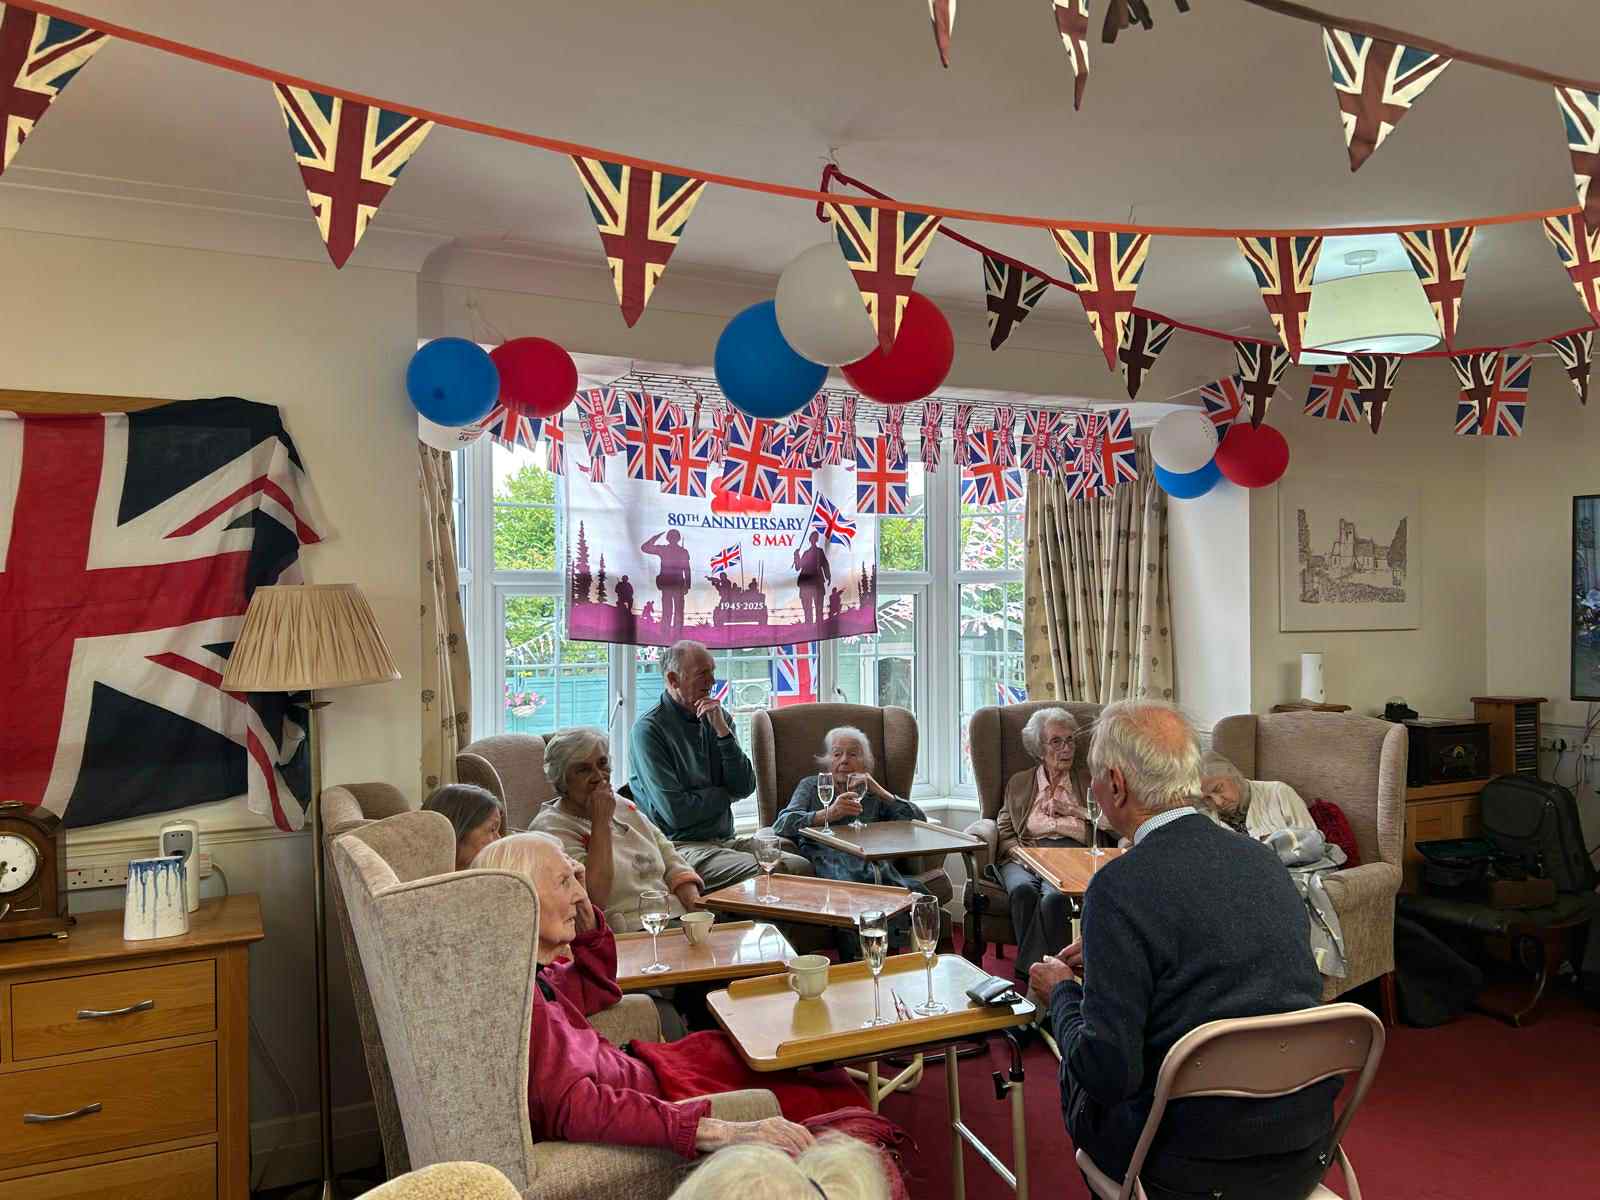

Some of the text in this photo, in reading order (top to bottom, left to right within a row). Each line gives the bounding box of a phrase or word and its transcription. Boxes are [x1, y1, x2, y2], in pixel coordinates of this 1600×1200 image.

[667, 513, 805, 531] 80TH ANNIVERSARY
[752, 534, 796, 547] 8 MAY
